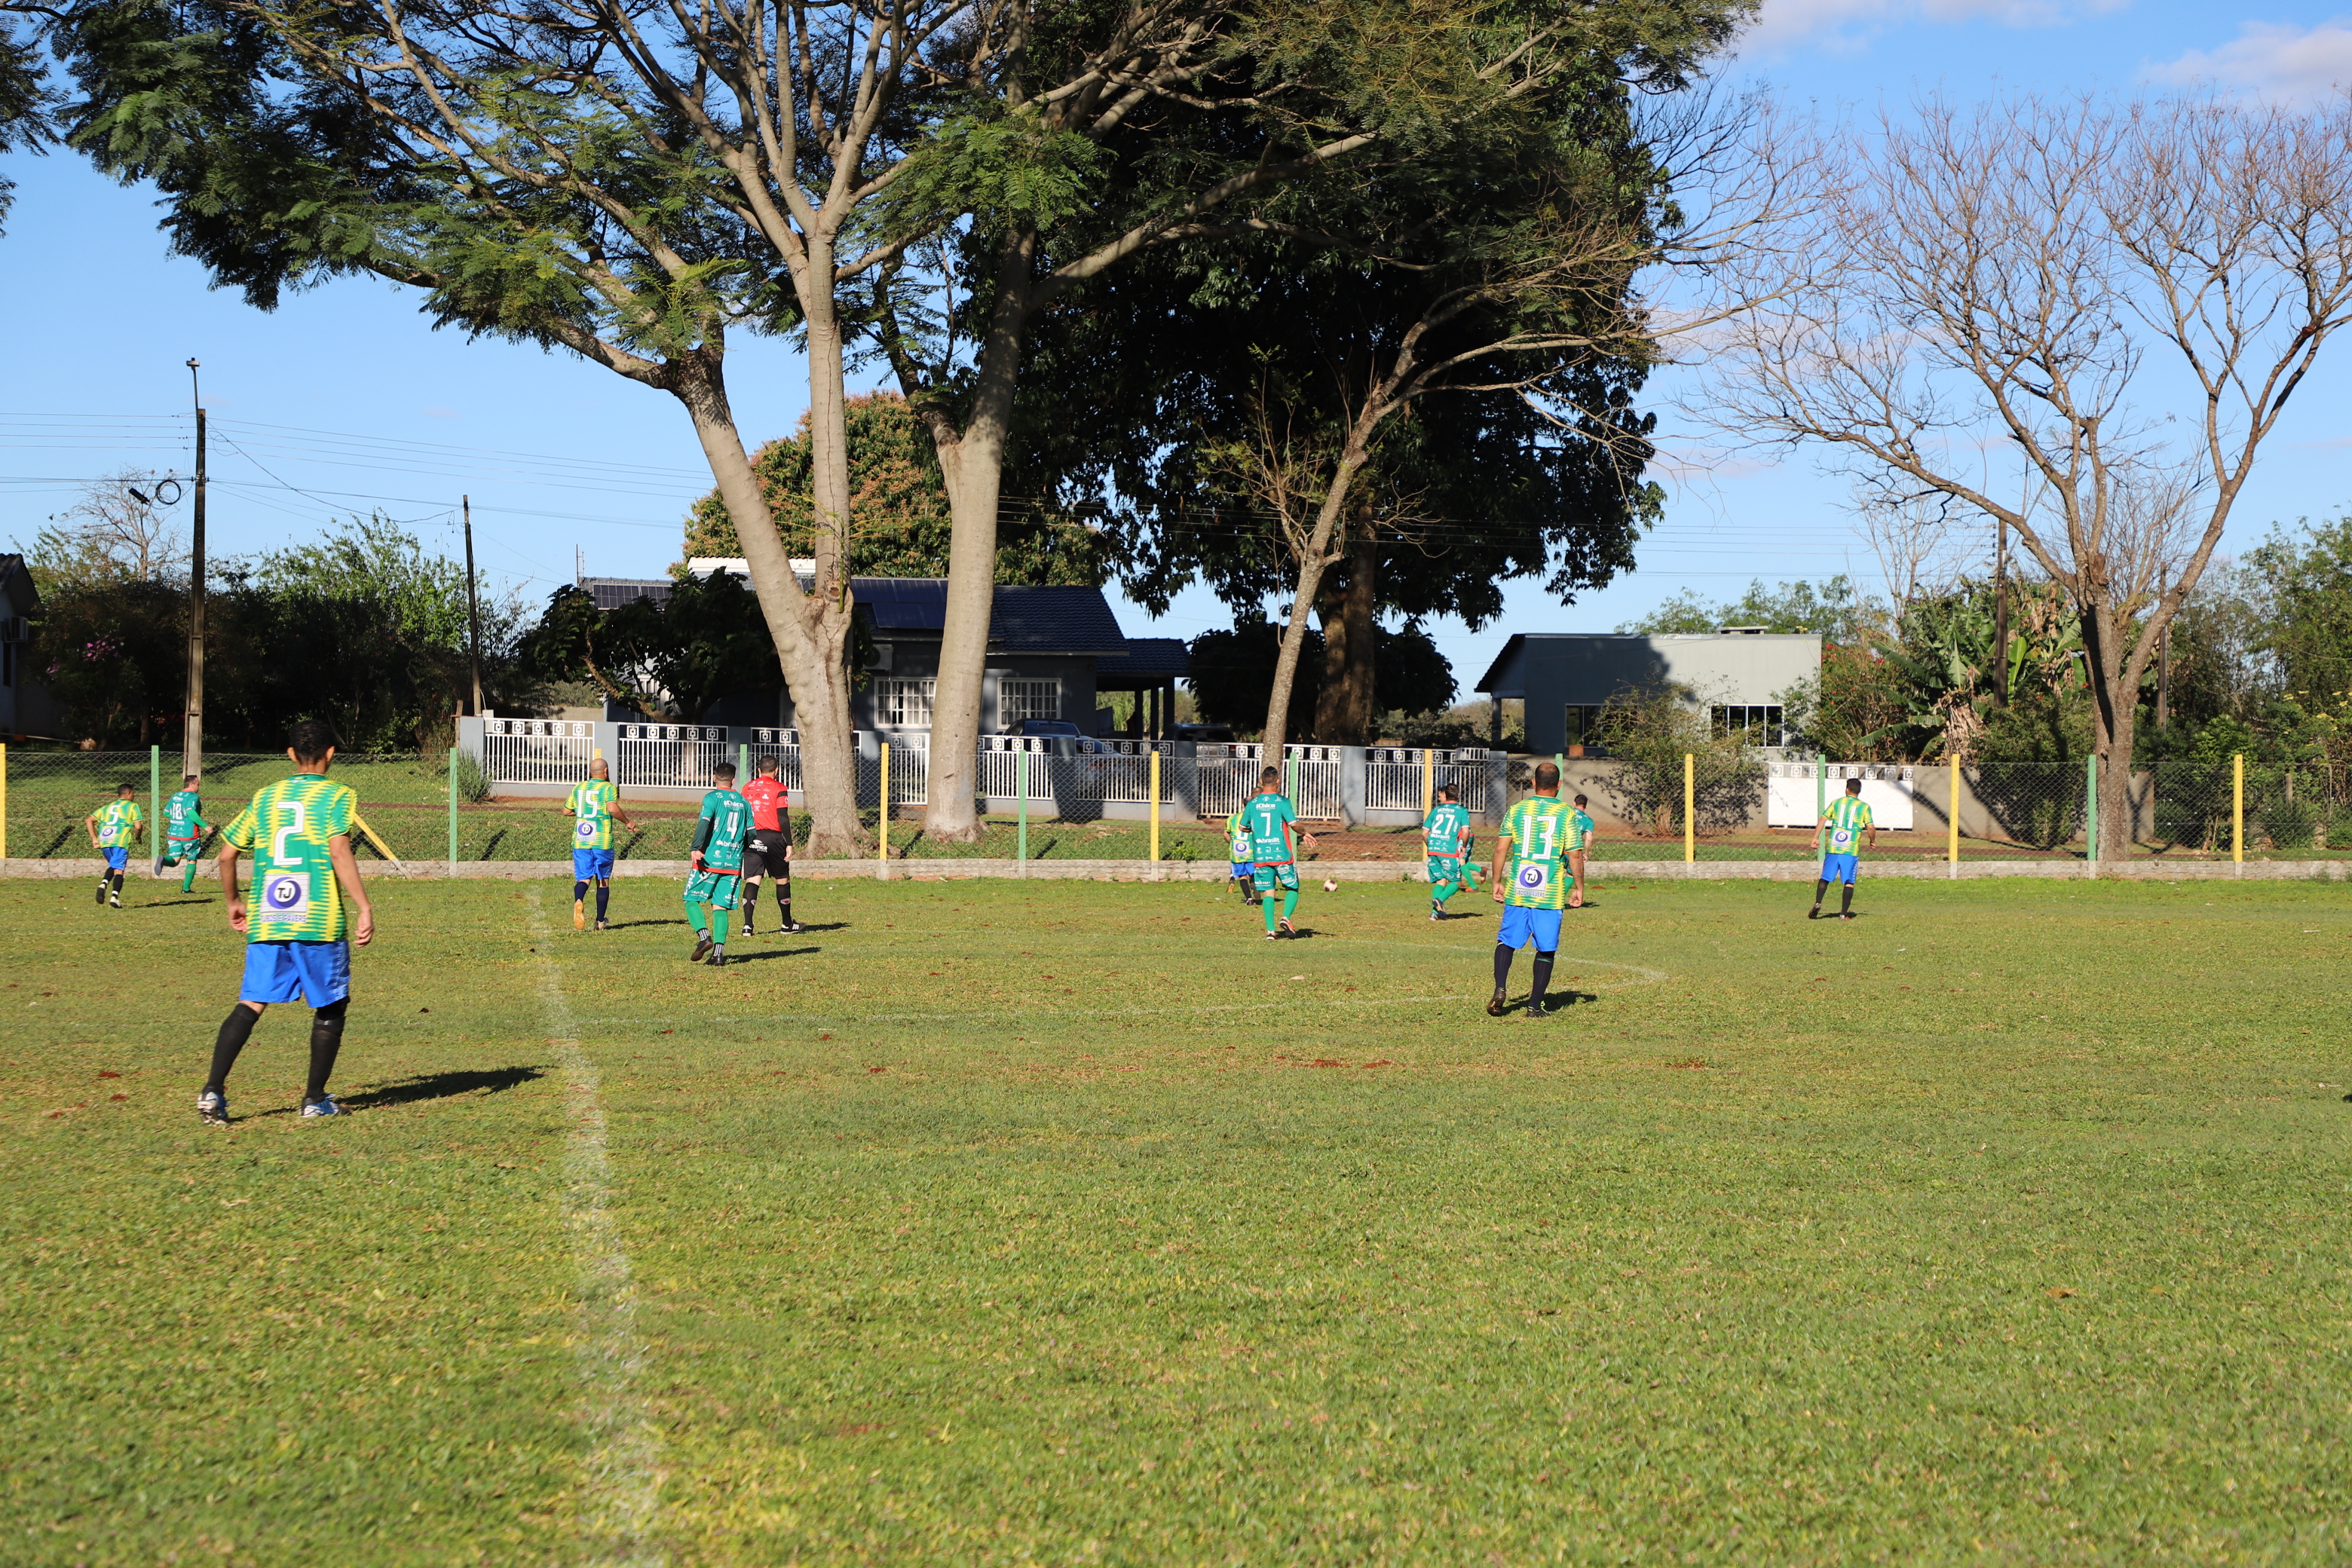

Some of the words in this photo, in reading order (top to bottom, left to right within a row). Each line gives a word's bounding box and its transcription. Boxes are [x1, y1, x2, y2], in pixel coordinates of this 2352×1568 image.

[106, 804, 121, 825] 5
[172, 803, 182, 819] 18
[577, 789, 599, 818] 15
[726, 811, 739, 839] 4
[1260, 812, 1270, 837] 7
[1432, 813, 1455, 835] 27
[1838, 804, 1857, 829] 11
[273, 801, 305, 866] 2
[1521, 815, 1557, 860] 13
[1527, 873, 1536, 881] TJ
[277, 887, 292, 899] TJ
